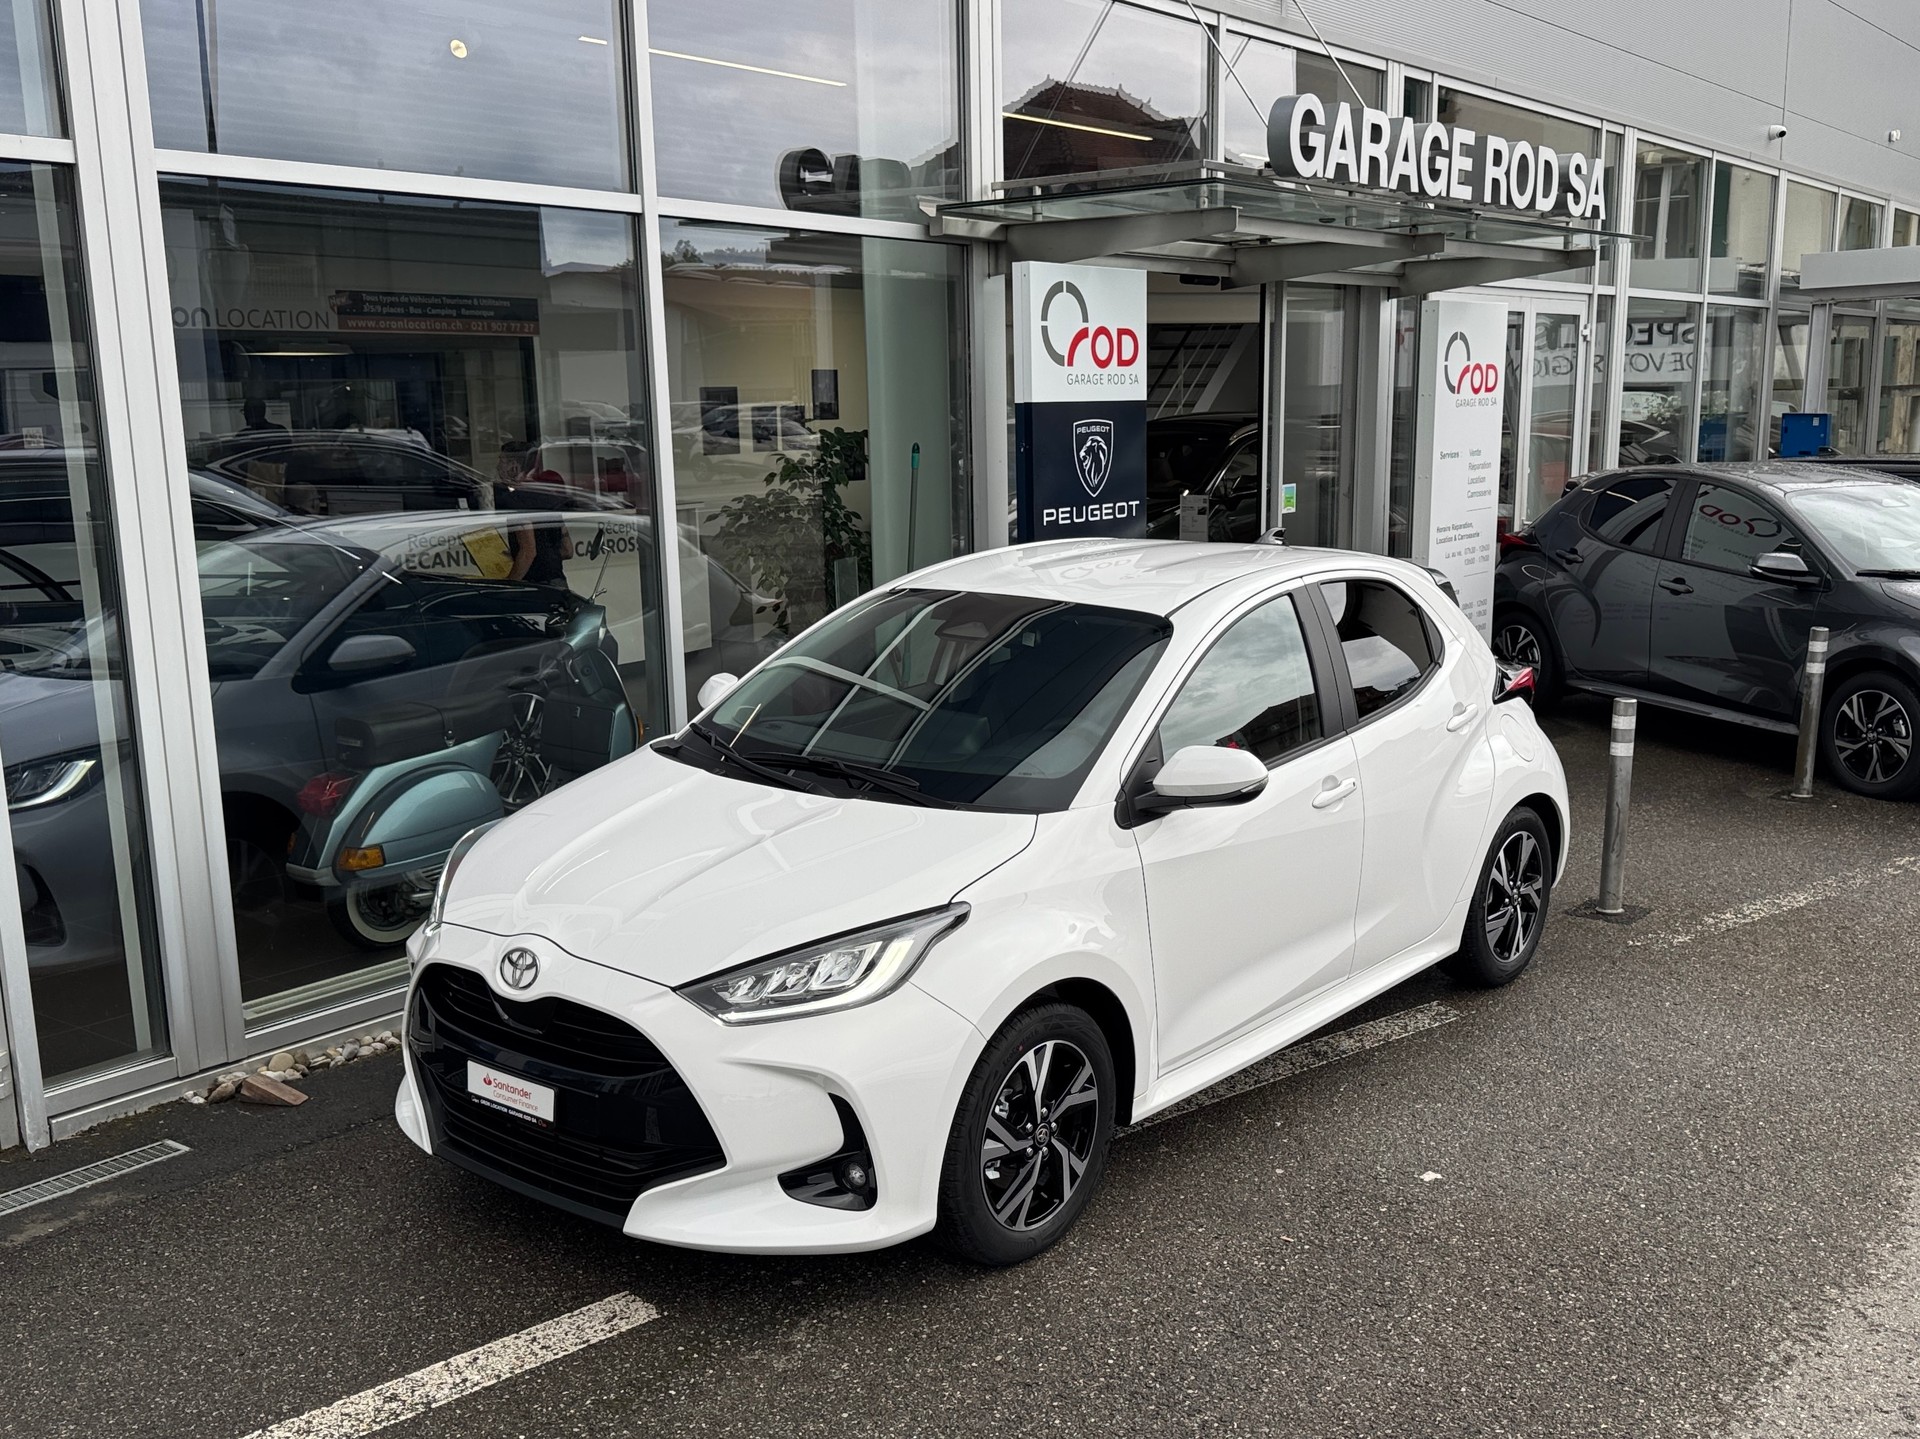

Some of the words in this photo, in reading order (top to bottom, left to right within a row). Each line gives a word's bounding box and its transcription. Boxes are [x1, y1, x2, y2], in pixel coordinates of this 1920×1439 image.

[1290, 93, 1476, 201] GARAGE
[1484, 134, 1559, 212] ROD
[1567, 152, 1606, 220] SA
[380, 295, 399, 304] types
[215, 307, 330, 330] LOCATION
[347, 318, 463, 330] www.oronlocation.ch
[471, 321, 488, 331] 021
[491, 322, 507, 331] 907
[1066, 373, 1104, 386] GARAGE
[1107, 374, 1127, 386] ROD
[1129, 374, 1139, 385] SA
[1455, 398, 1477, 408] GARAGE
[1076, 425, 1110, 434] PEUGEOT
[1043, 500, 1140, 526] PEUGEOT
[493, 1078, 532, 1100] Santander
[493, 1090, 518, 1105] Consumer
[518, 1098, 539, 1112] Finance
